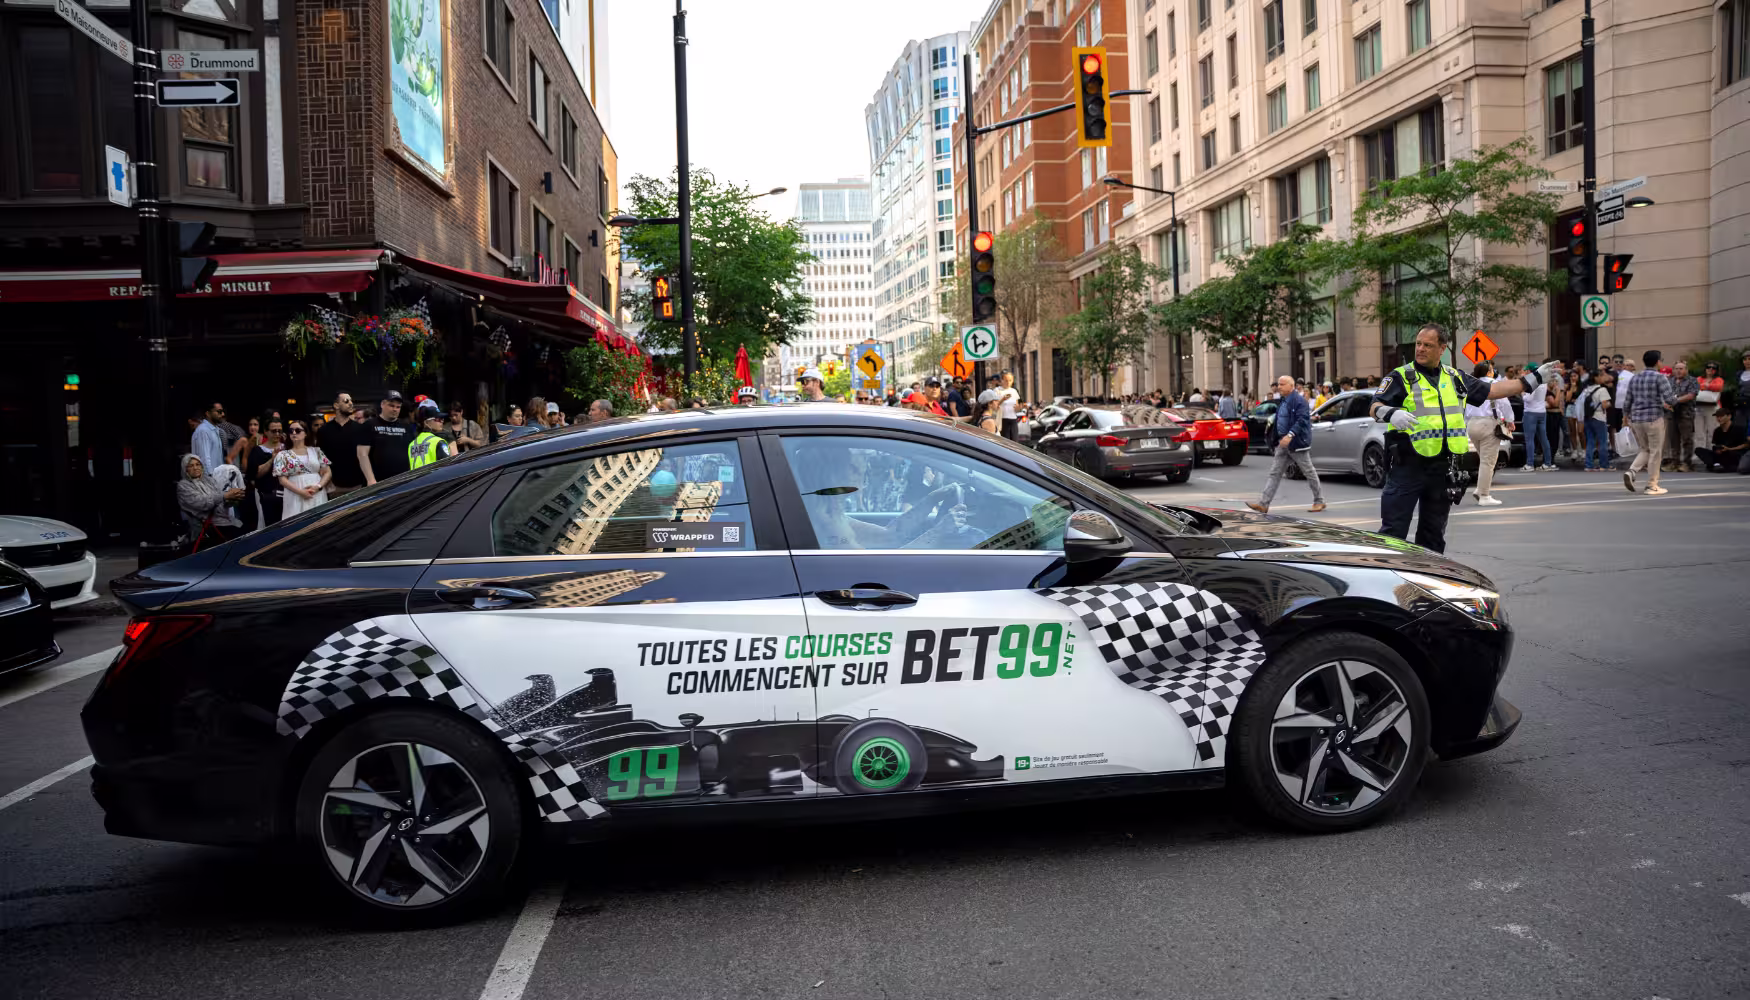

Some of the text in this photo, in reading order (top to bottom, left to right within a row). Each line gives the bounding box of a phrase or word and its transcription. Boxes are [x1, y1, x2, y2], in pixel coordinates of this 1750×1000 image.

[58, 0, 118, 51] De Maisonneuve
[190, 57, 254, 68] Drummond
[221, 281, 272, 293] MINUIT
[411, 444, 428, 456] CADET
[670, 533, 715, 541] WRAPPED
[637, 631, 893, 667] TOUTES LES COURSES
[900, 622, 1063, 685] BET99
[666, 661, 889, 695] COMMENCENT SUR
[1016, 759, 1029, 768] 19+
[1078, 758, 1109, 766] responsable
[606, 745, 680, 801] 99
